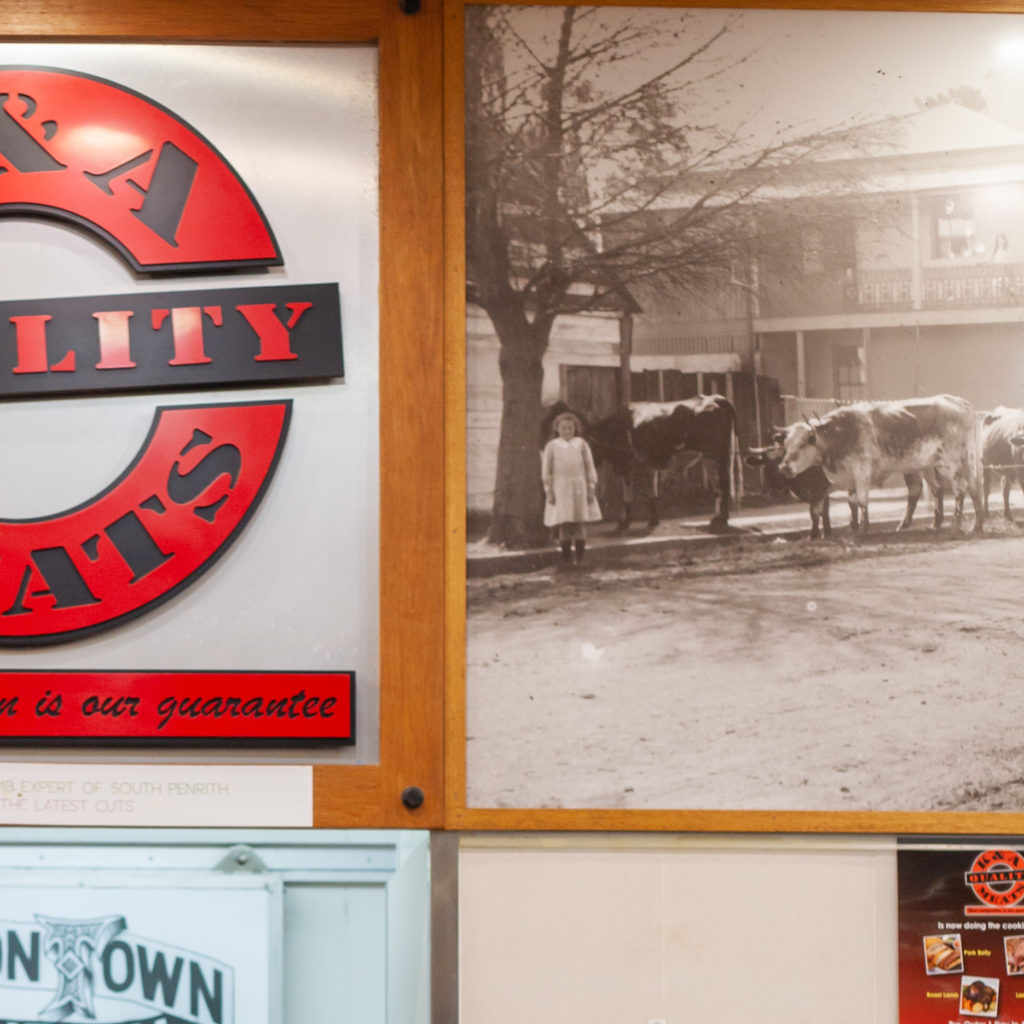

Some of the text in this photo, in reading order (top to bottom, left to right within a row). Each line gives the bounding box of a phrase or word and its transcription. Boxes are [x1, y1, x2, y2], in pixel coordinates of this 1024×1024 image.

[35, 686, 64, 719] is
[81, 693, 141, 719] our
[156, 688, 339, 725] guarantee
[20, 780, 74, 794] EXPERT
[81, 781, 103, 795] OF
[110, 781, 162, 795] SOUTH
[167, 782, 229, 796] PENRITH
[34, 799, 88, 813] LATEST
[95, 800, 135, 813] CUTS
[963, 921, 986, 932] doing
[987, 921, 1001, 930] the
